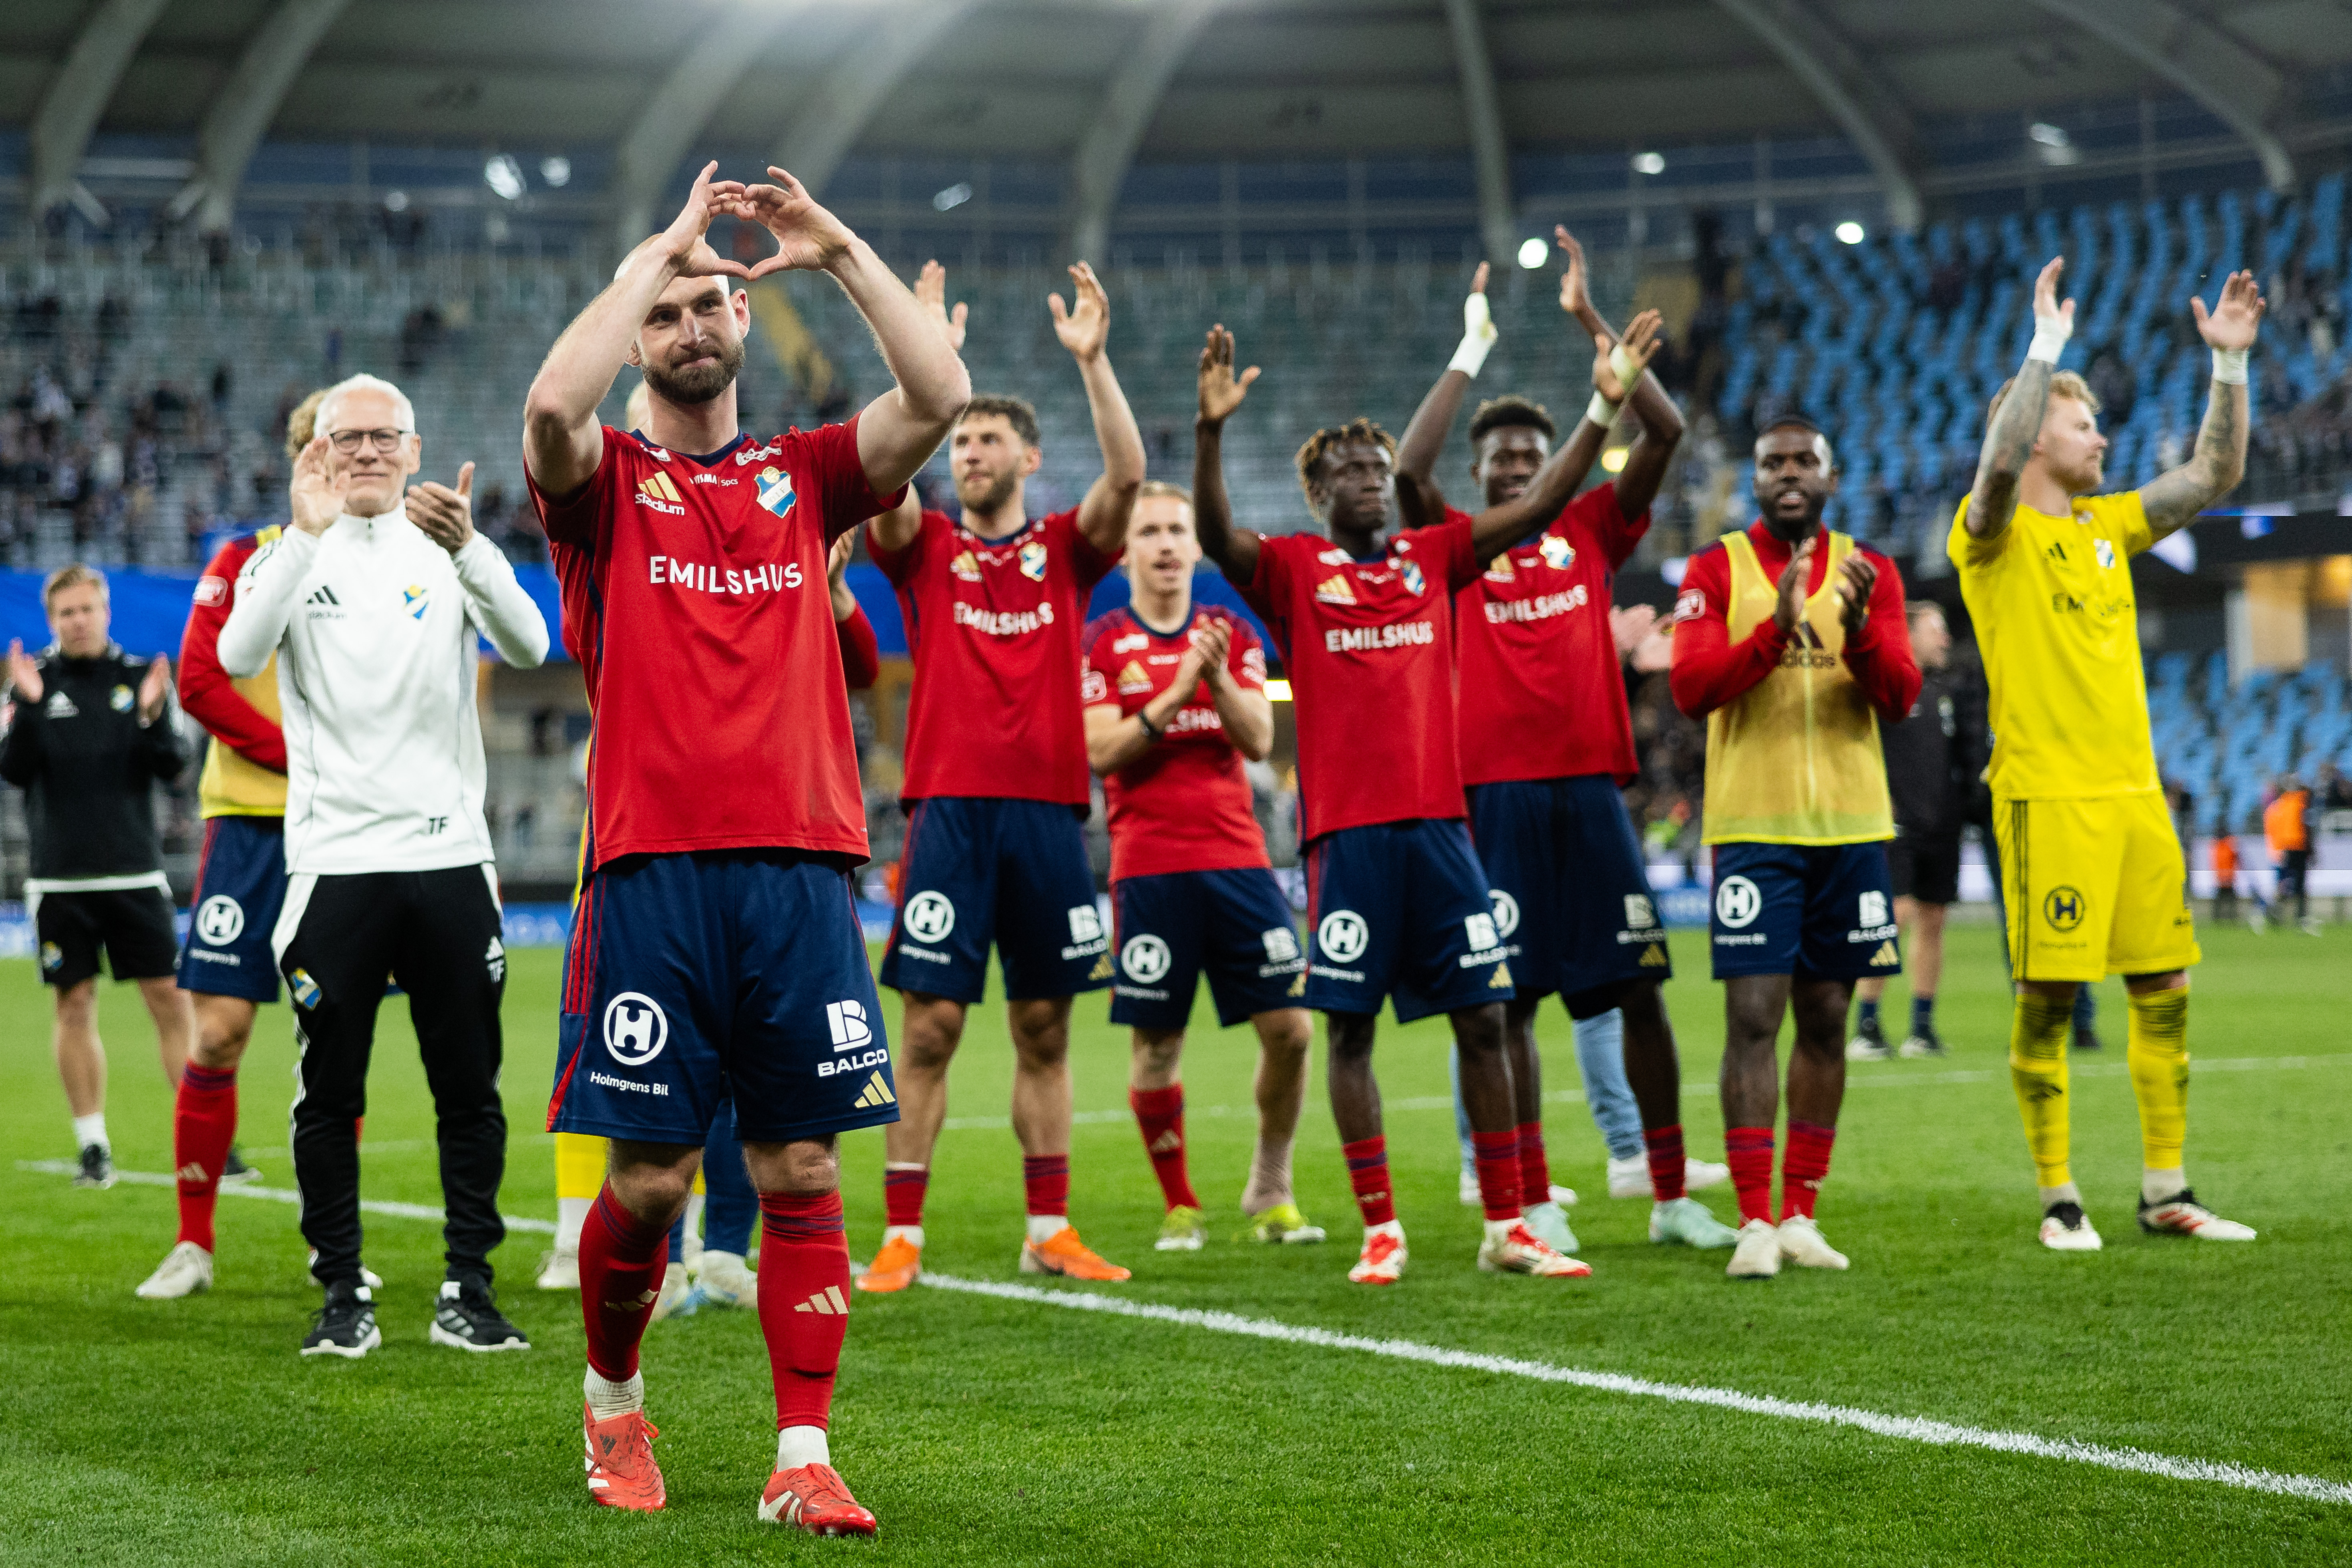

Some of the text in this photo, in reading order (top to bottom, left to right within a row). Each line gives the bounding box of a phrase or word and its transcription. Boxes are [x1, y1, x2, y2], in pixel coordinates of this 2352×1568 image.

[693, 474, 718, 485] VISMA
[635, 492, 685, 516] stadium
[769, 487, 785, 502] OIF
[650, 556, 803, 595] EMILSHUS
[1484, 584, 1589, 624] EMILSHUS
[953, 601, 1054, 635] EMILSHUS
[1325, 621, 1434, 652] EMILSHUS
[429, 816, 449, 835] TF
[1847, 924, 1899, 943] BALCO
[826, 1000, 872, 1053] B
[818, 1049, 888, 1077] BALCO
[590, 1071, 668, 1096] Holmgrens Bil
